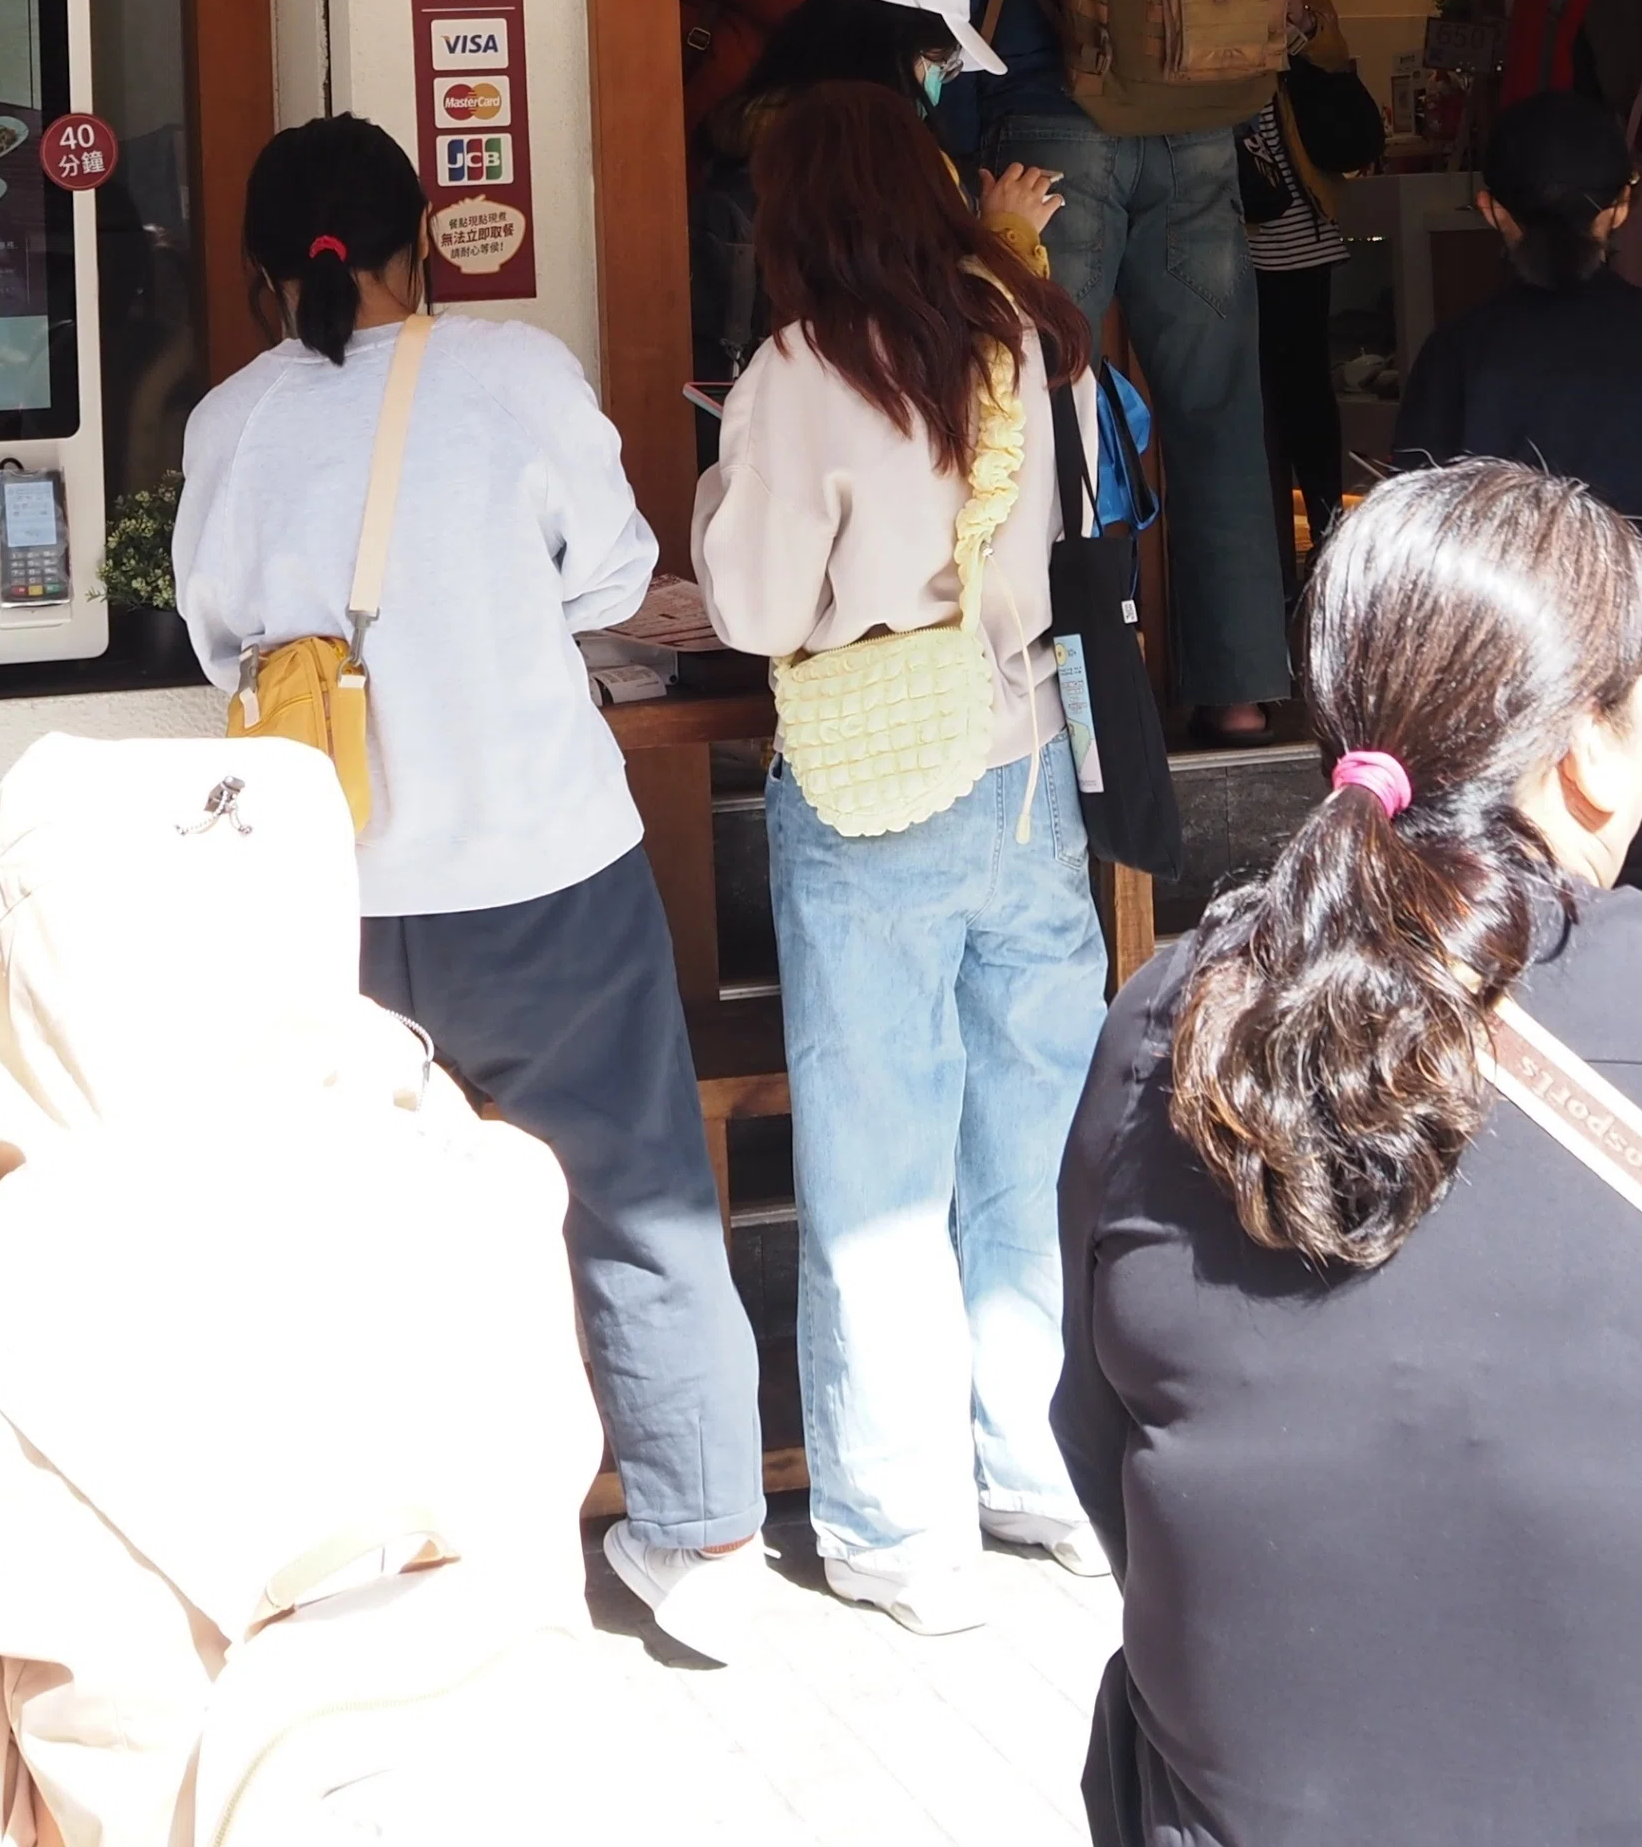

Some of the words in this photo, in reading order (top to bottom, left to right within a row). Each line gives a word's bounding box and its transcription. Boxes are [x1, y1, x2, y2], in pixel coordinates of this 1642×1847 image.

[441, 34, 499, 54] VISA
[444, 96, 500, 109] MasterCard
[59, 124, 96, 151] 40
[58, 152, 107, 178] 分鐘
[448, 152, 500, 168] JCB
[449, 211, 507, 231] 餐點現點現煮
[441, 223, 515, 248] 無法立即取餐
